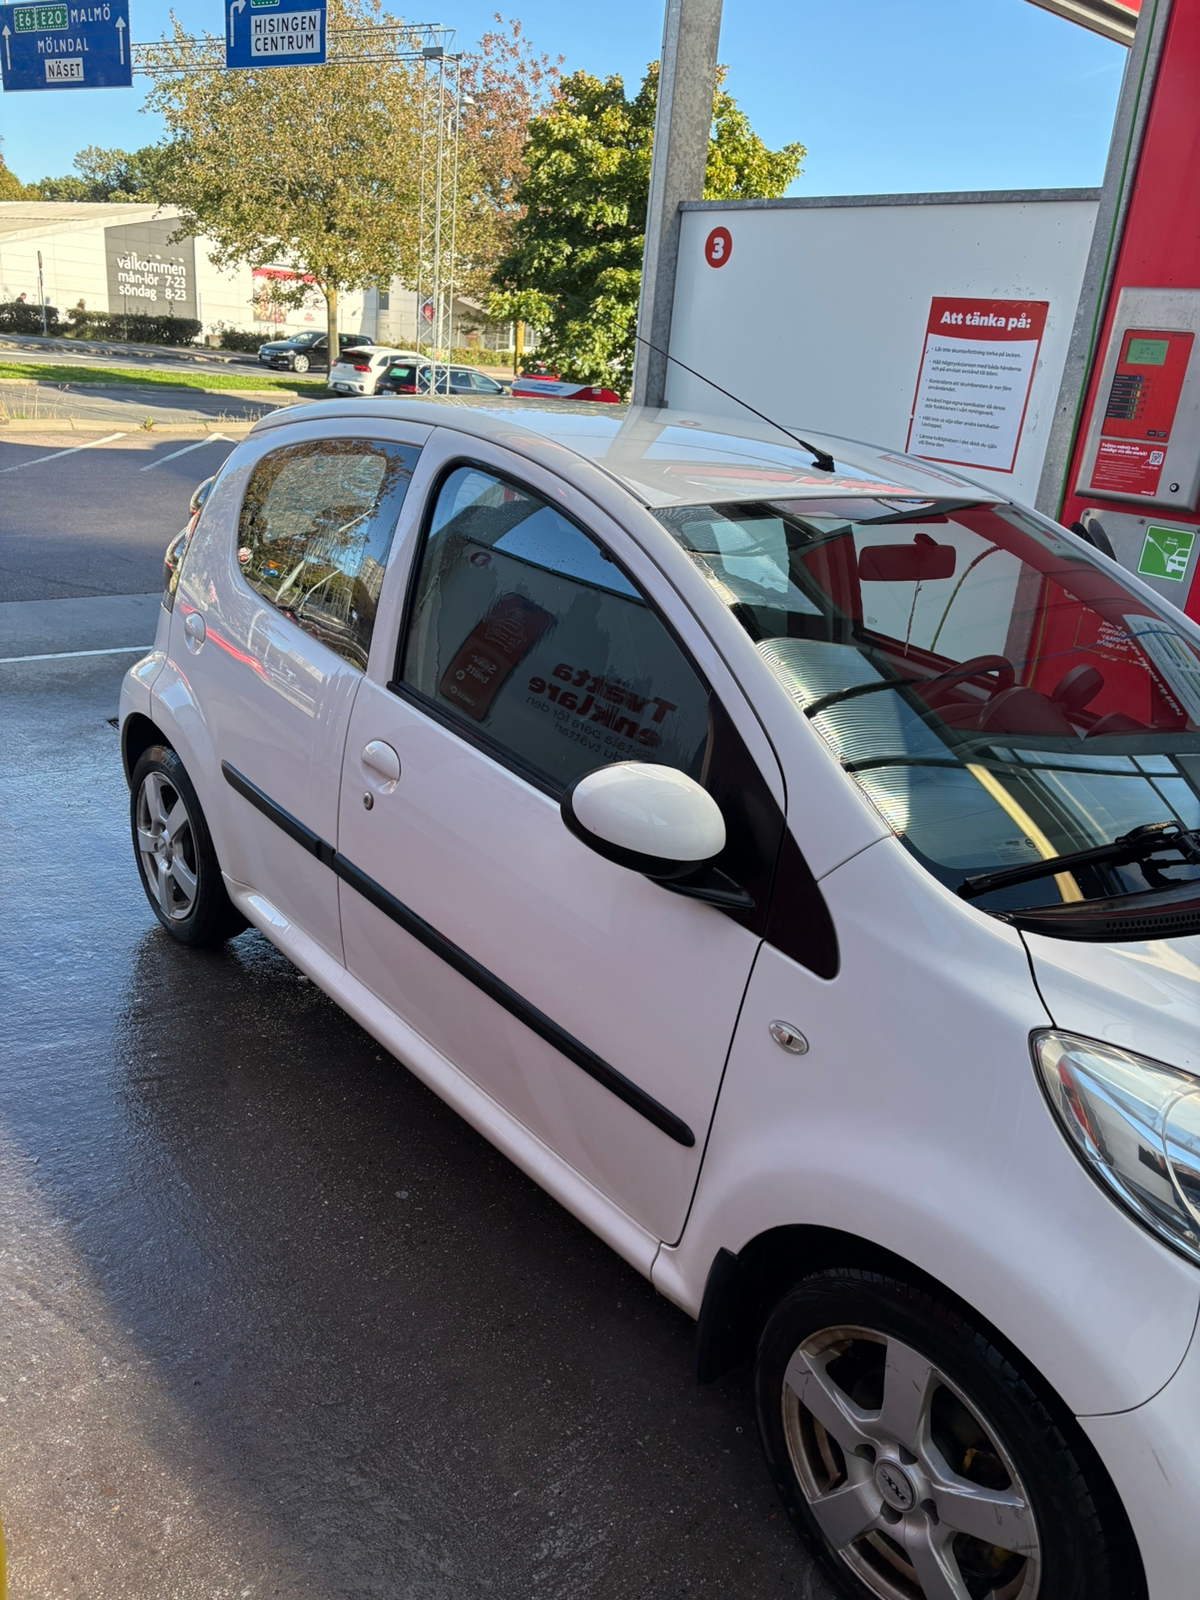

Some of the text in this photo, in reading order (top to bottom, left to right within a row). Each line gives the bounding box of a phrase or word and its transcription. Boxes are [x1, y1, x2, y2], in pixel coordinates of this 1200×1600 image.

[18, 3, 111, 27] E6 E20 MALMÖ
[254, 15, 317, 34] HISINGEN
[37, 36, 89, 54] MÖLNDAL
[254, 34, 315, 52] CENTRUM
[48, 61, 81, 78] NÄSET
[712, 236, 725, 260] 3
[116, 254, 186, 276] välkommen
[118, 272, 159, 286] mån-lör
[119, 284, 187, 301] söndag 8-23
[940, 311, 1032, 331] Att tänka på:
